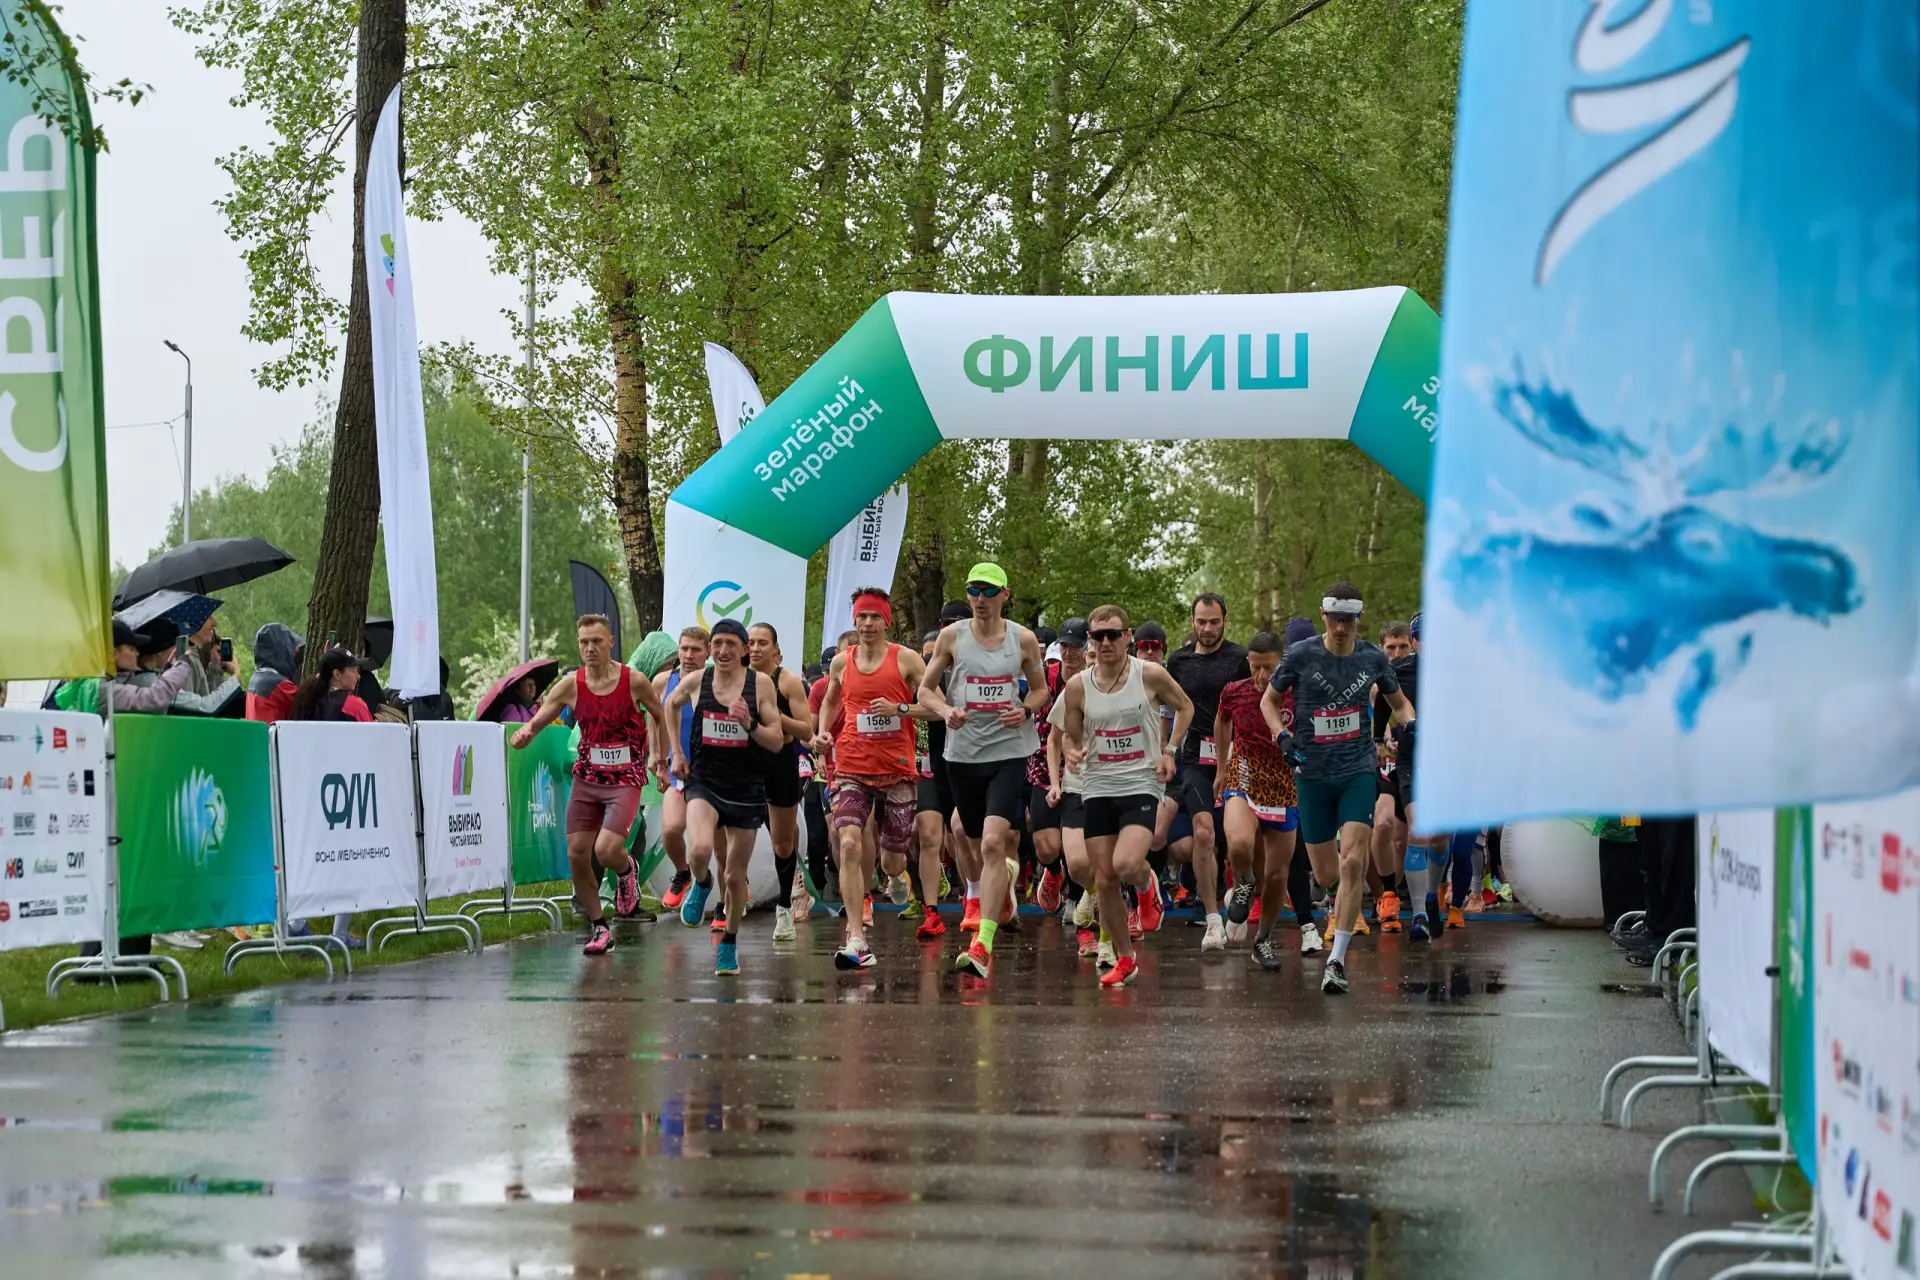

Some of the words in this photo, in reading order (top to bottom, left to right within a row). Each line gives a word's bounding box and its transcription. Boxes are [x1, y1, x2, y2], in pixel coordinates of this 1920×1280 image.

[963, 333, 1308, 393] ФИНИШ
[753, 375, 864, 482] зелёный
[771, 398, 884, 502] марафон
[871, 515, 882, 562] ЧИСТЫЙ
[977, 686, 1003, 697] 1072
[713, 722, 738, 734] 1005
[866, 715, 891, 726] 1568
[1325, 716, 1351, 729] 1181
[1106, 737, 1132, 749] 1152
[599, 750, 622, 760] 1017
[448, 812, 482, 833] ВЫБИРАЮ
[315, 851, 335, 863] ФОНД
[337, 846, 390, 862] МЕЛЬНИЧЕНКО
